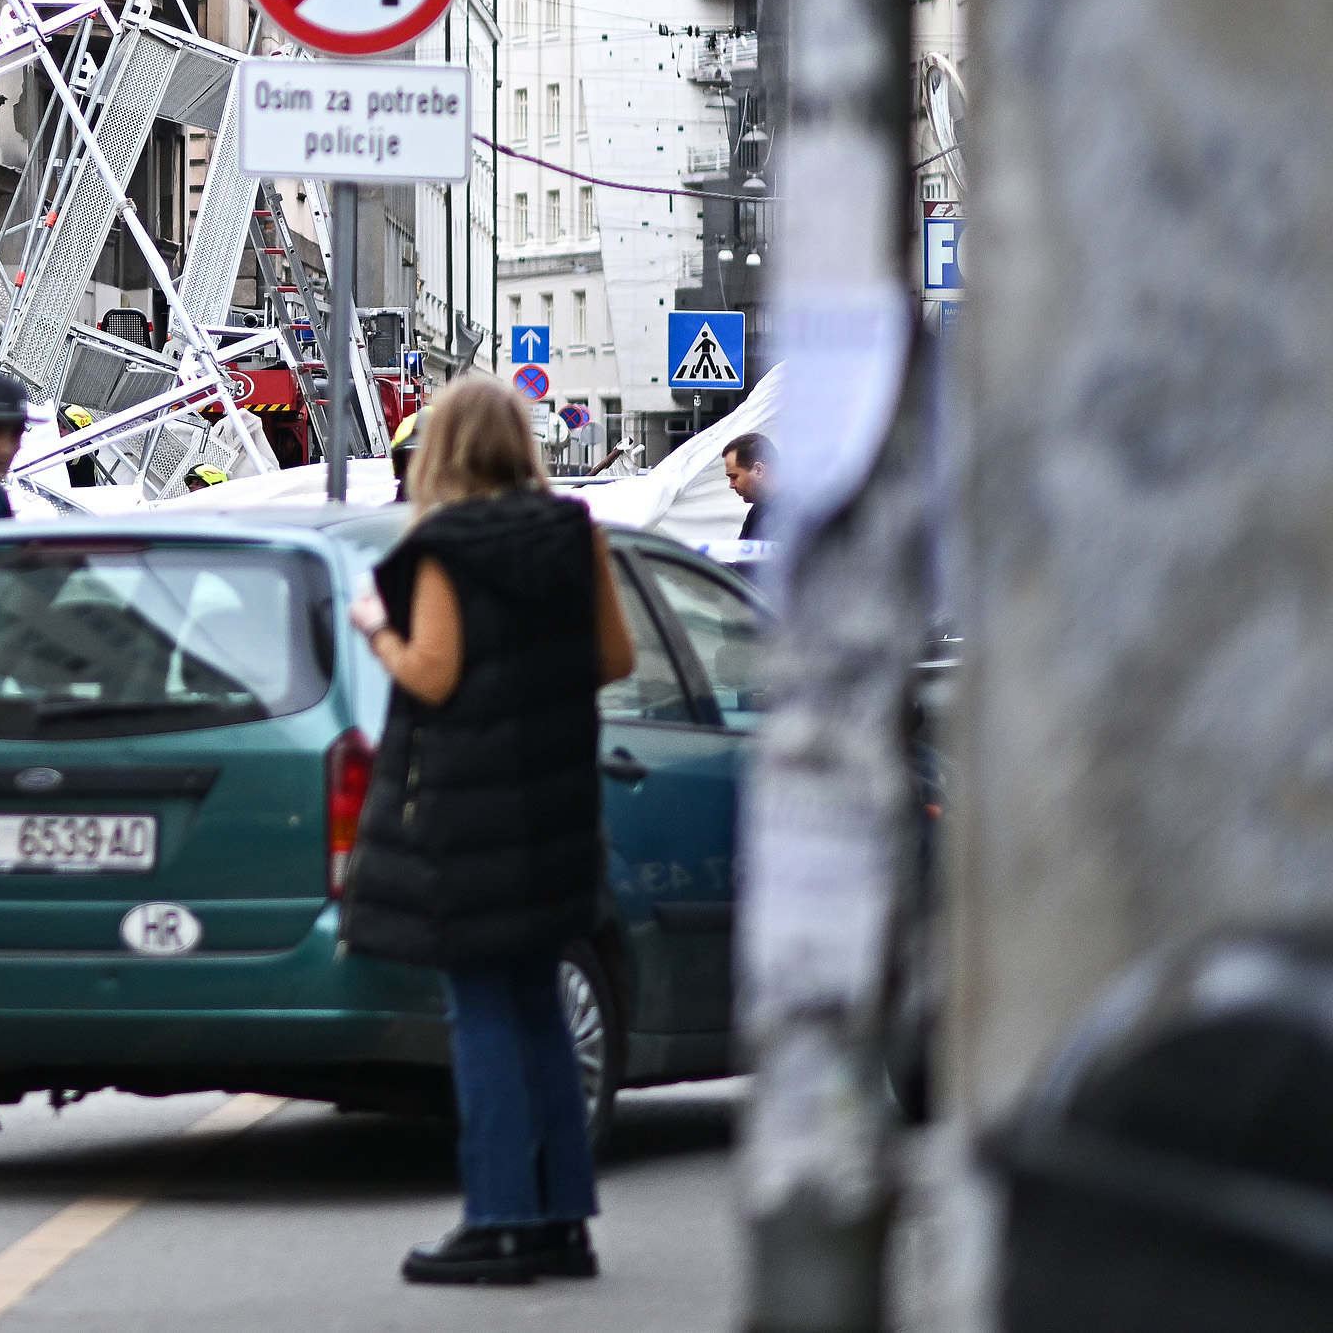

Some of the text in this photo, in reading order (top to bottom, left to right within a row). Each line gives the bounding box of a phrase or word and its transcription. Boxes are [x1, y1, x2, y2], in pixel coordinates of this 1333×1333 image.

[253, 80, 459, 120] Osim za potrebe
[304, 126, 401, 164] policije
[142, 910, 183, 947] HR
